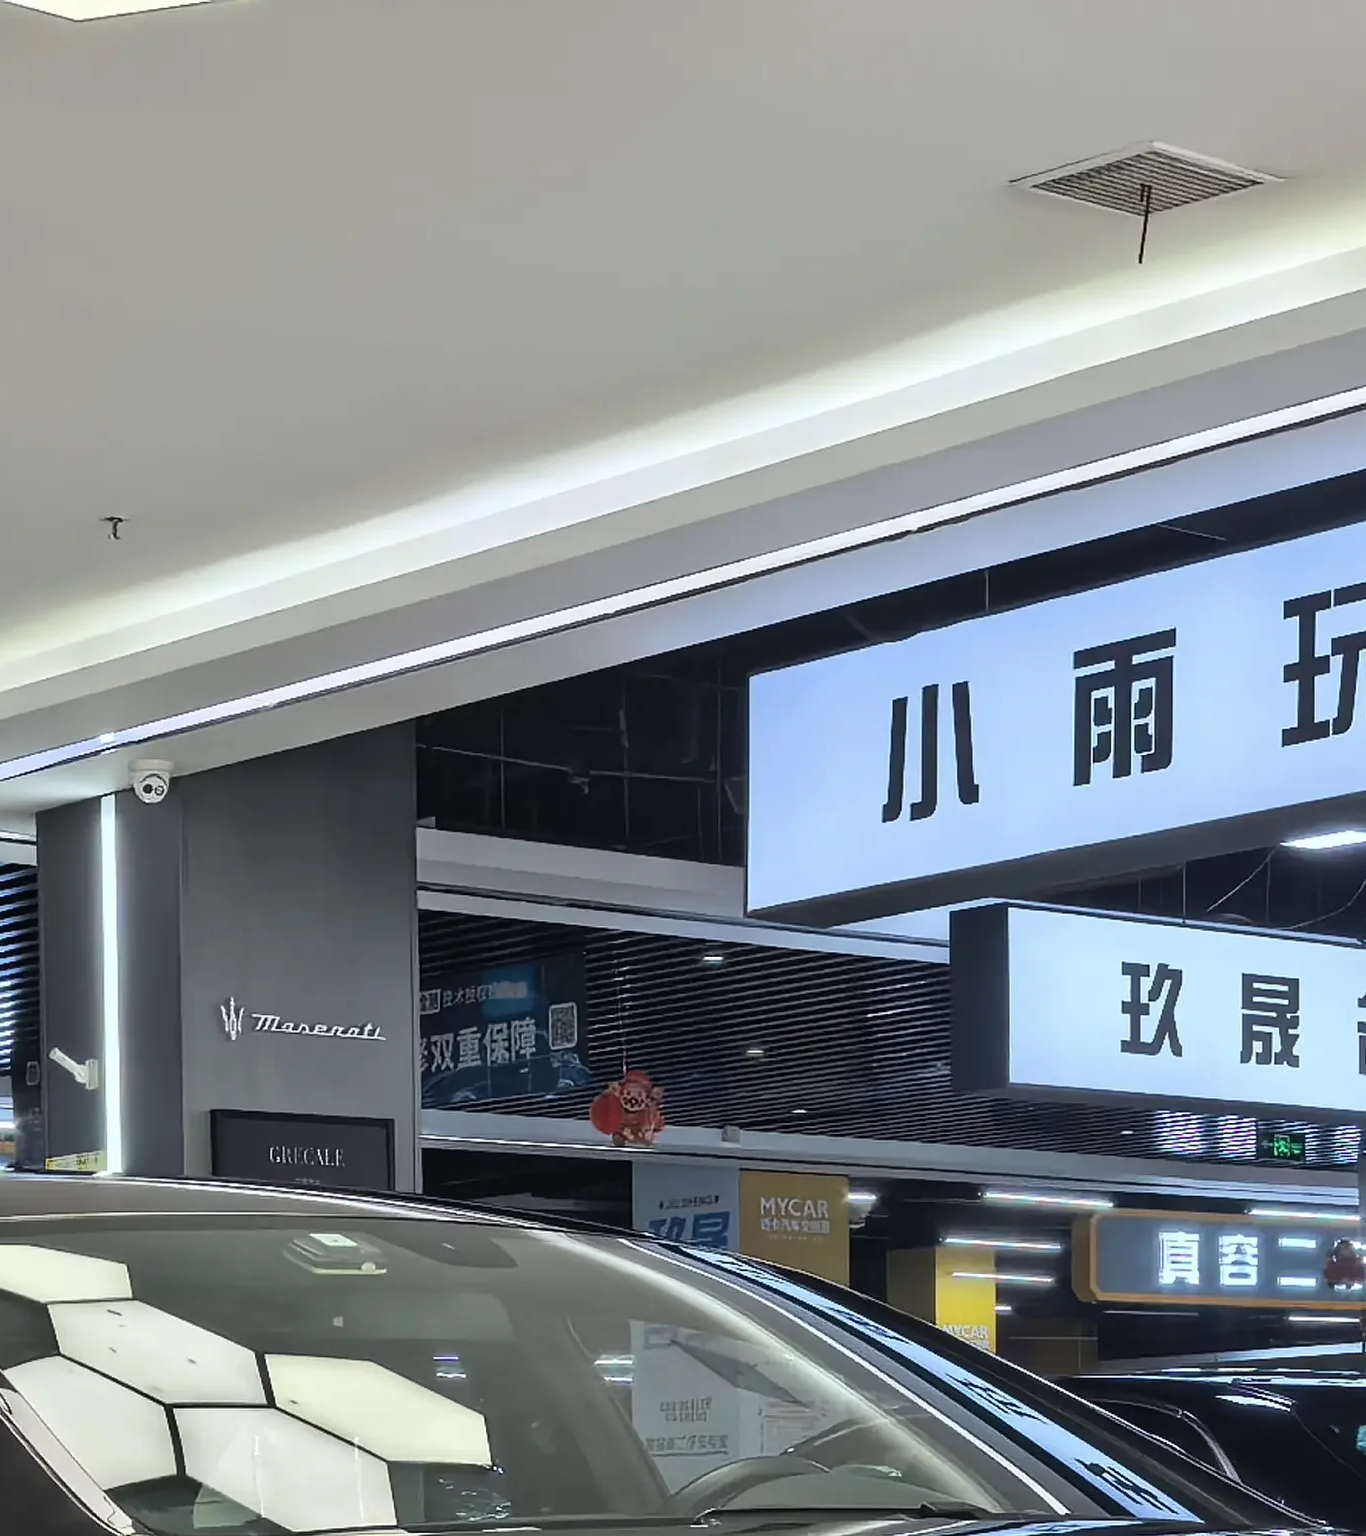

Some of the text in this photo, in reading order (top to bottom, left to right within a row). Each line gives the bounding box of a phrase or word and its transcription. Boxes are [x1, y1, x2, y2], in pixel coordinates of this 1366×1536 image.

[251, 1014, 386, 1040] Maserati
[269, 1146, 345, 1167] GRECALE
[760, 1196, 829, 1218] MYCAR
